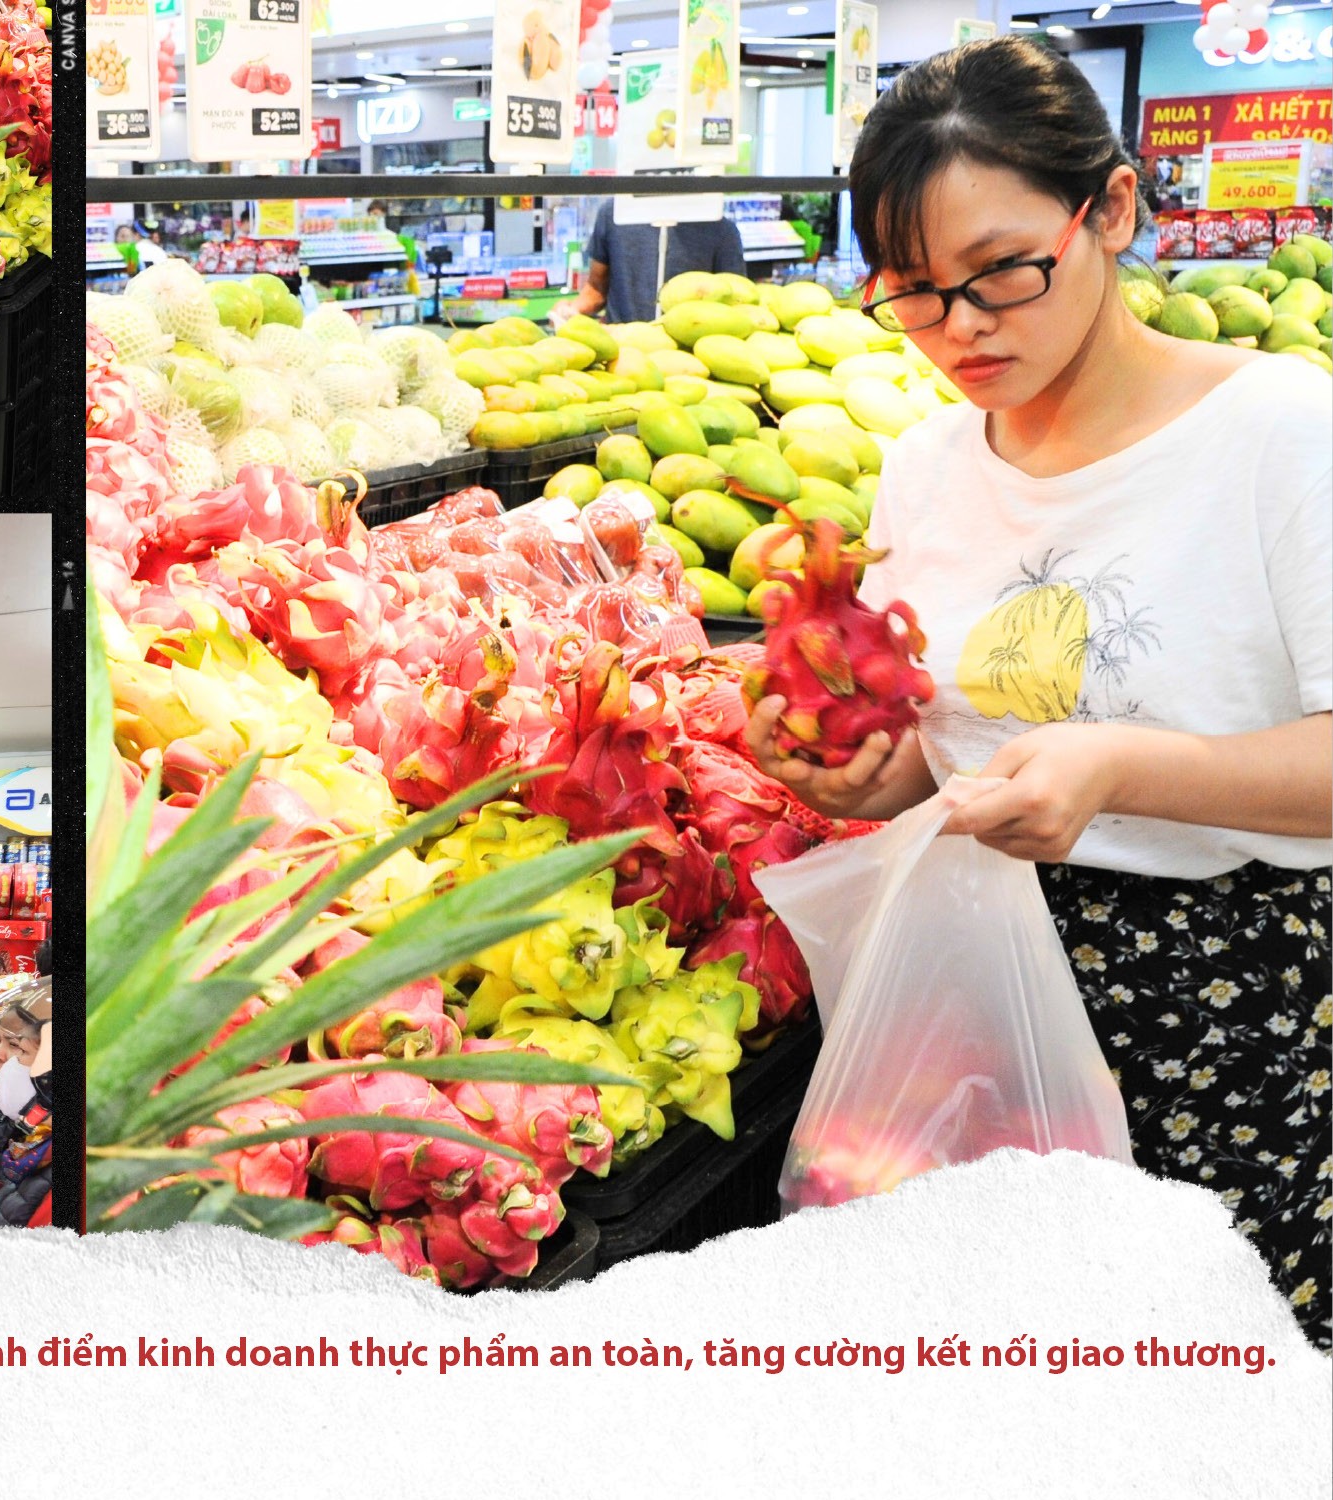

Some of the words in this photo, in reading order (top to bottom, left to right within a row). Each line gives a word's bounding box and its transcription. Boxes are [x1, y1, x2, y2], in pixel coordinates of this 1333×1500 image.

[1153, 105, 1197, 124] MUA
[1202, 105, 1211, 121] 1
[1233, 96, 1264, 122] XẢ
[1268, 92, 1314, 121] HẾT
[1203, 129, 1212, 144] 1
